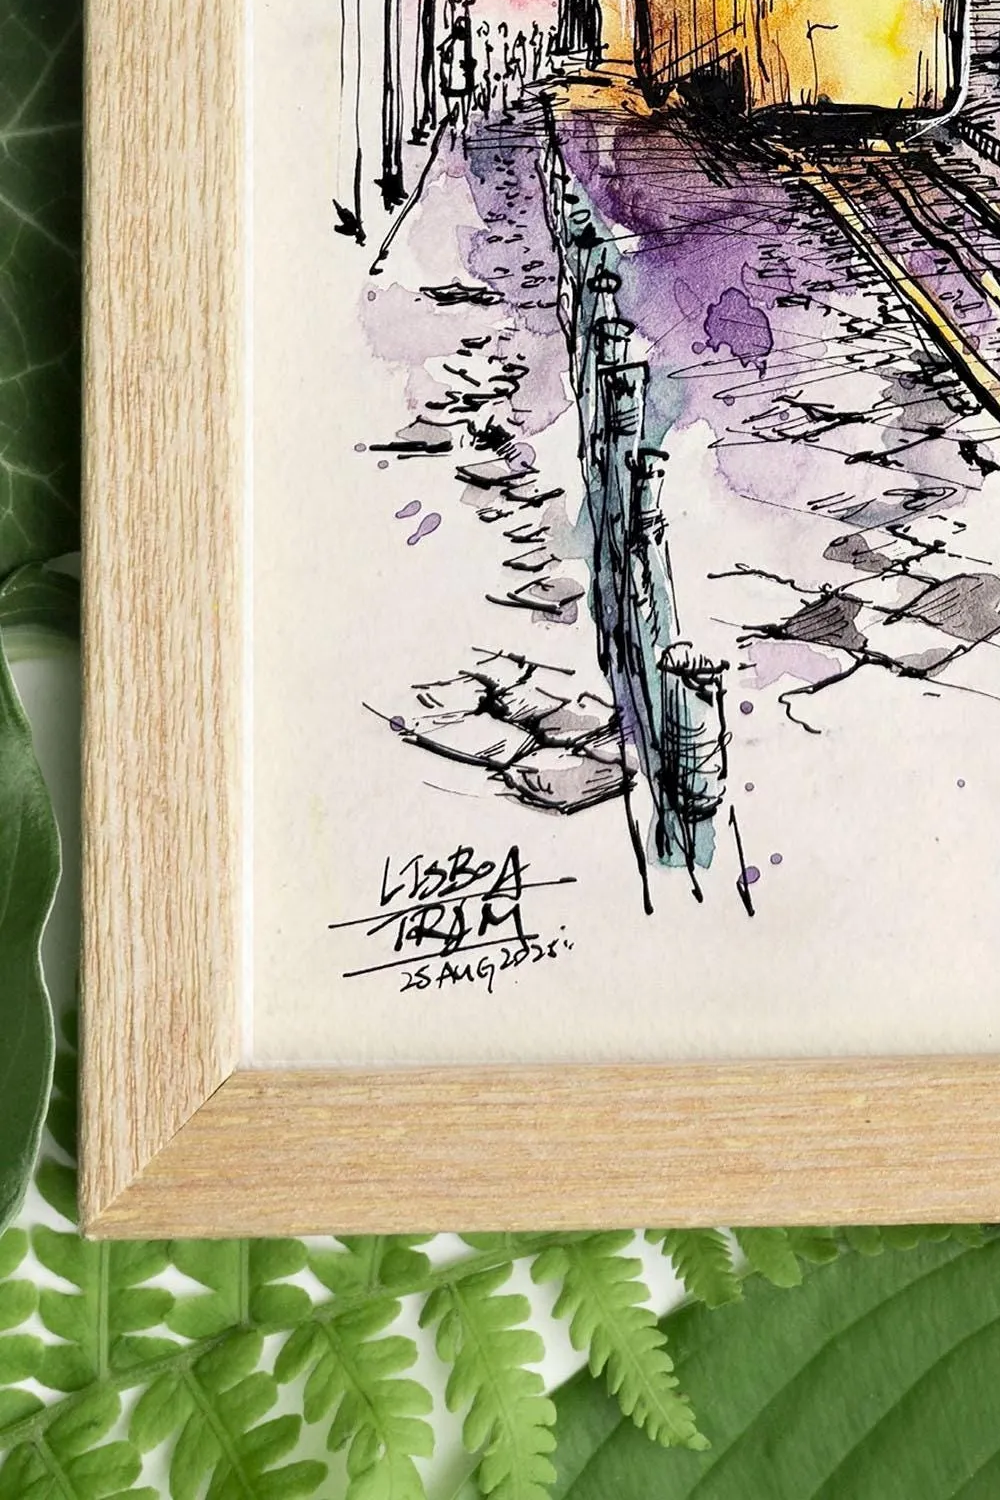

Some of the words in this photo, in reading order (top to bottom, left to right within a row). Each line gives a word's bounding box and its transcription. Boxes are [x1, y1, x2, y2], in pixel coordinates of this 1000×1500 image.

[380, 845, 531, 906] LISBOA
[367, 900, 529, 956] TRAM
[436, 956, 495, 994] AUG
